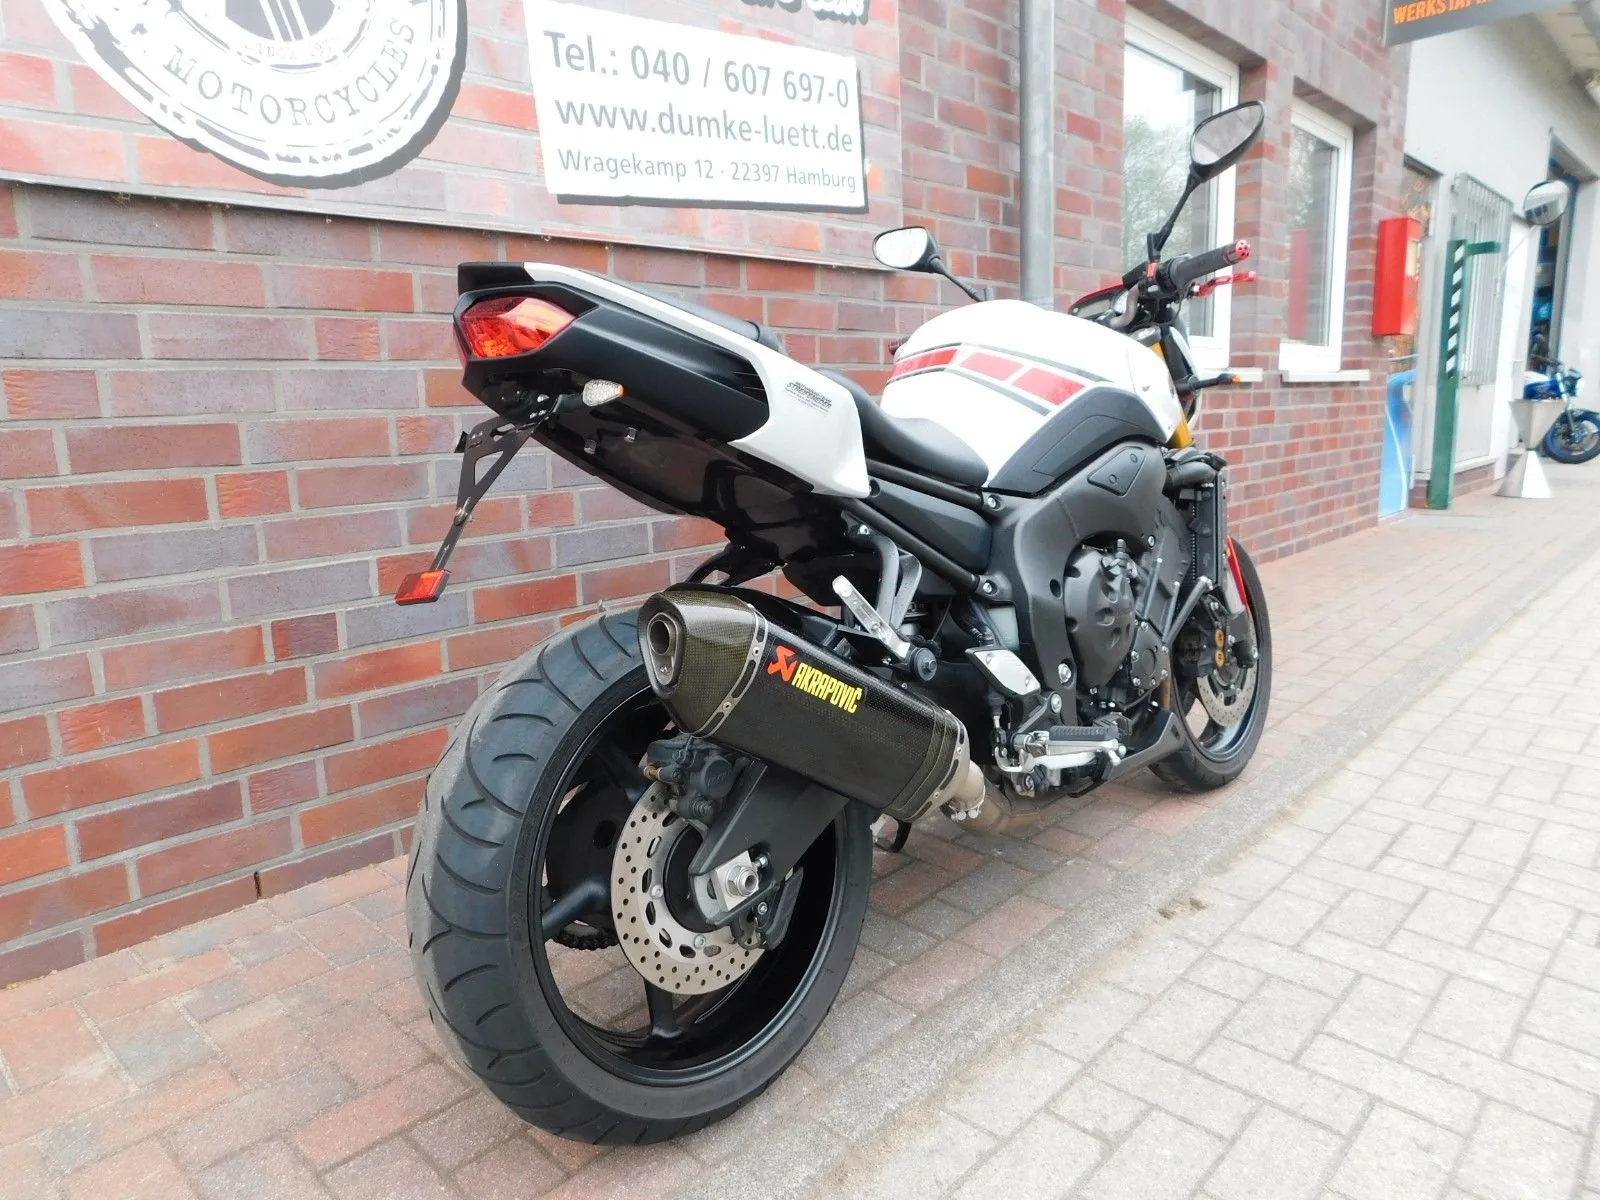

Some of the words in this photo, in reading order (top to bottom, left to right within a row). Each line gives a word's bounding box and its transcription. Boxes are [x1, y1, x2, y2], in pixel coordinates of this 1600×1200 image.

[162, 19, 415, 126] MOTORCYCLES
[543, 30, 618, 76] Tel.:
[631, 45, 690, 86] 040
[724, 60, 771, 97] 607
[783, 70, 849, 108] 697-0
[554, 99, 853, 153] www.dumke-luett.de
[557, 148, 687, 182] Wragekamp
[694, 160, 714, 179] 12
[731, 162, 779, 183] 22397
[786, 167, 856, 193] Hamburg
